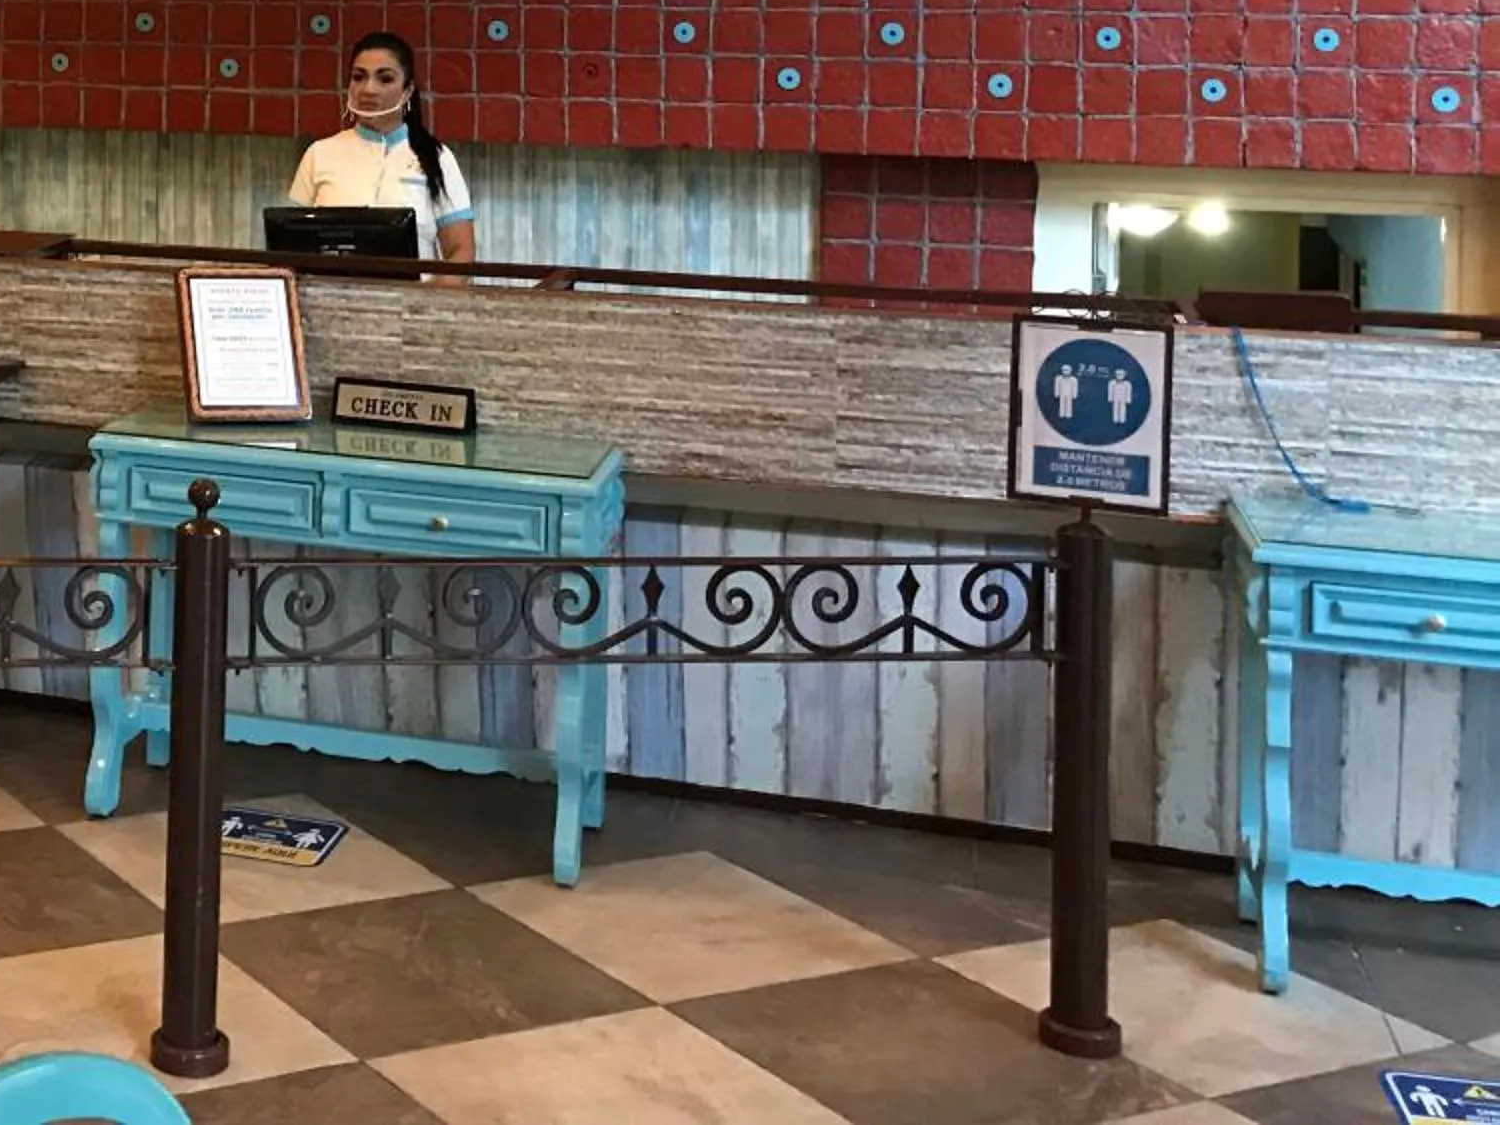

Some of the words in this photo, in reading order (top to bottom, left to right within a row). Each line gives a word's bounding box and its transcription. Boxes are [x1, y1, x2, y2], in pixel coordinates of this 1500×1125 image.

[351, 396, 419, 420] CHECK
[430, 404, 453, 423] IN
[1059, 450, 1125, 466] MANTENER
[1049, 462, 1113, 476] DISTANCIA
[1115, 468, 1132, 479] DE
[1075, 478, 1126, 492] METROS
